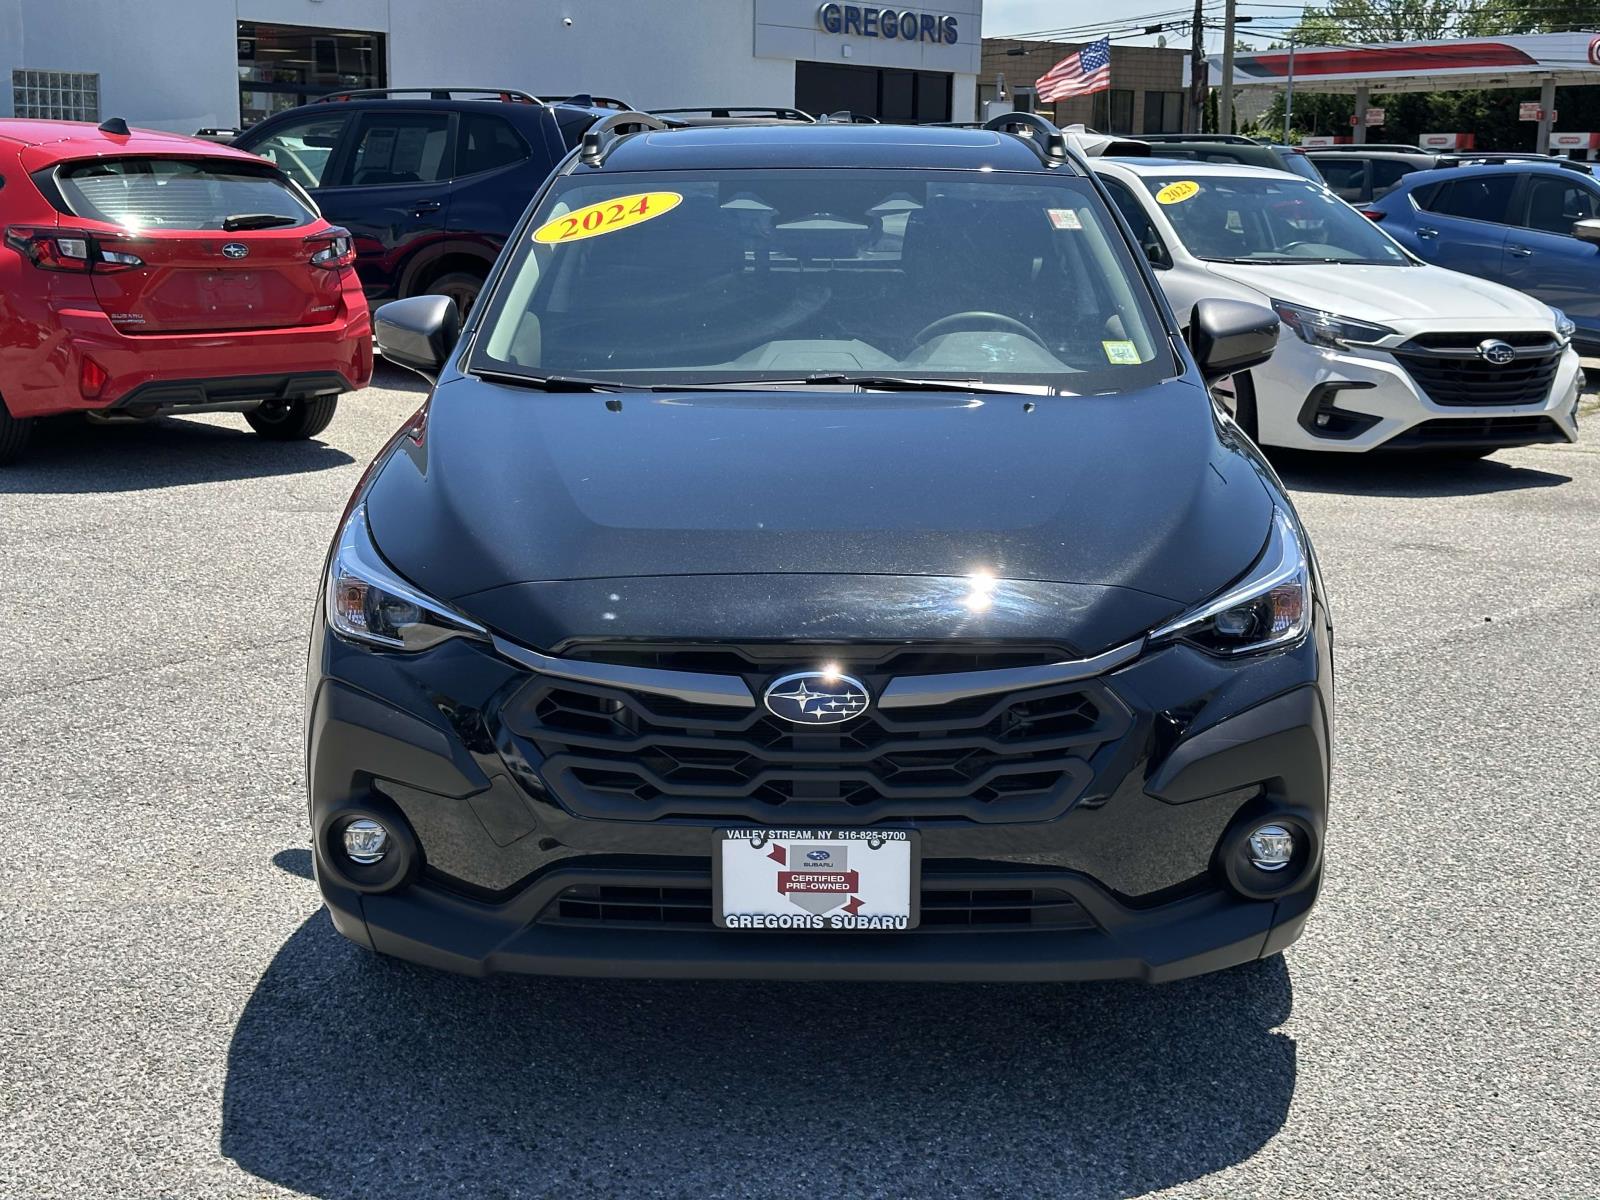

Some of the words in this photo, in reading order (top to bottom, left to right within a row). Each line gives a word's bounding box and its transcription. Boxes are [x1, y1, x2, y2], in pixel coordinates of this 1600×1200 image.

[820, 2, 958, 45] GREGORIS
[1163, 183, 1193, 201] 2023
[559, 196, 650, 240] 2024
[727, 830, 766, 840] VALLEY
[769, 831, 814, 840] STREAM,
[817, 831, 833, 840] NY
[838, 831, 906, 841] 516-825-8700
[786, 882, 850, 890] PRE-OWNED
[725, 915, 824, 929] GREGORIS
[831, 916, 908, 930] SUBARU
